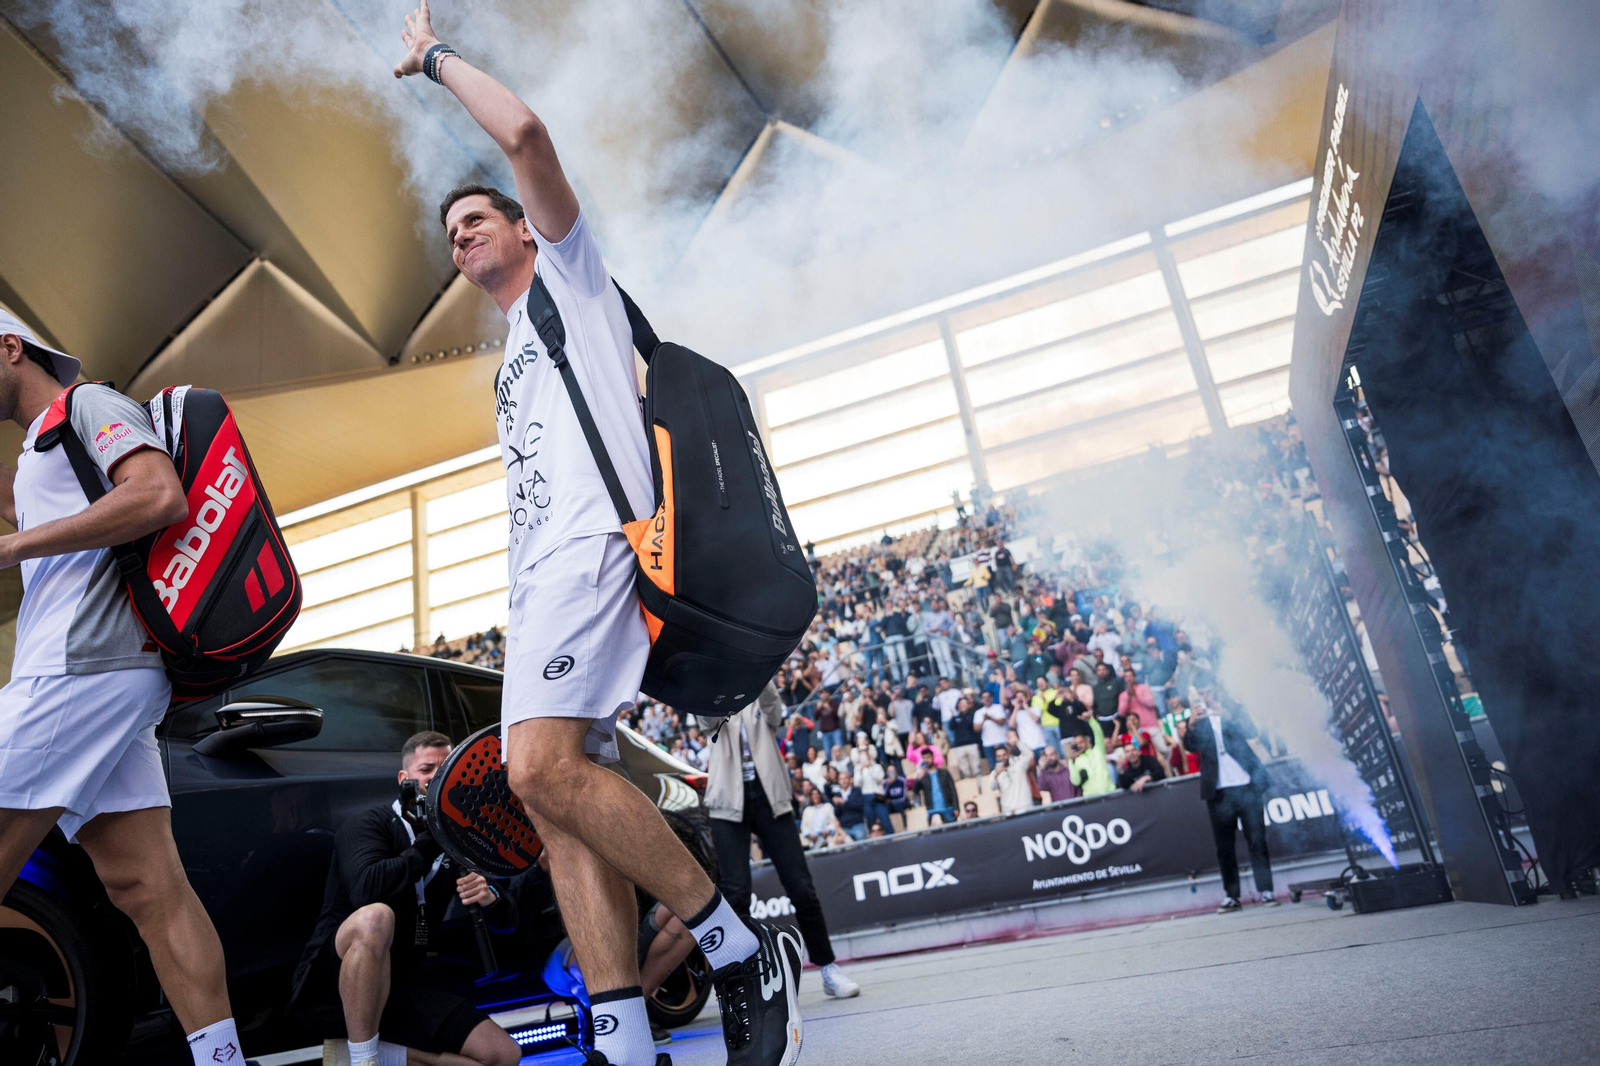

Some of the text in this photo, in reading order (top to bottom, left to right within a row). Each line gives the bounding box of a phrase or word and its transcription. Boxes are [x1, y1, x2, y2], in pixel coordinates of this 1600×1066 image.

[1330, 83, 1349, 155] PADEL
[1337, 202, 1364, 300] SEVILLA P2
[98, 427, 132, 454] Red Bull
[747, 430, 788, 538] Bullpadel
[650, 498, 666, 571] HAC
